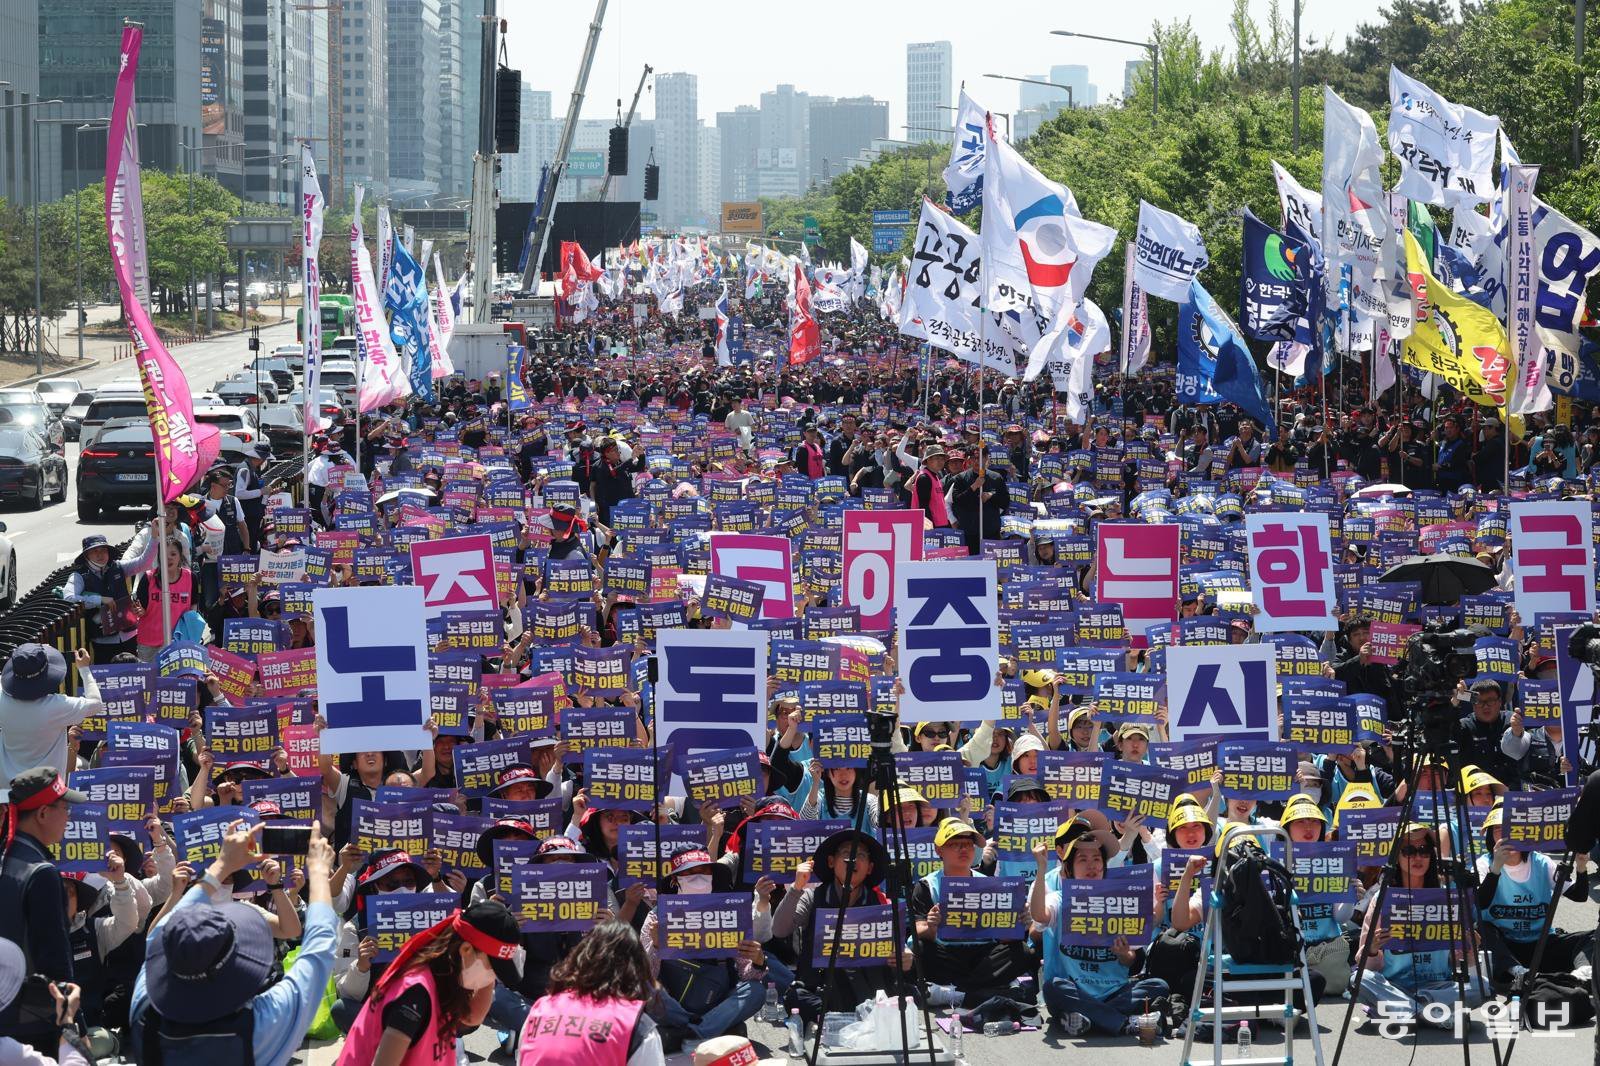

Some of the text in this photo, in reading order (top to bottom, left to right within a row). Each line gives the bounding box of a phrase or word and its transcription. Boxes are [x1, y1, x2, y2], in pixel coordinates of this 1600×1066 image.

[1516, 206, 1530, 237] 노동
[1516, 241, 1531, 303] 사각지대
[1252, 523, 1328, 617] 한
[1517, 515, 1586, 610] 국
[550, 569, 588, 580] 노동입법
[608, 567, 644, 580] 노동입법
[550, 581, 592, 591] 즉각 이행!
[608, 578, 646, 590] 즉각 이행!
[707, 585, 756, 605] 노동입법
[707, 595, 755, 617] 즉각 이행!
[1362, 598, 1402, 614] 노동입법
[1465, 605, 1502, 619] 노동입법
[535, 613, 575, 626] 노동입법
[642, 613, 679, 628] 노동입법
[809, 617, 852, 629] 노동입법
[1079, 615, 1118, 626] 노동입법
[1382, 611, 1403, 624] 이행!
[1482, 618, 1504, 628] 이행!
[229, 629, 272, 641] 노동입법
[447, 622, 493, 633] 노동입법
[534, 622, 579, 638] 즉각 이행!
[1080, 628, 1101, 639] 즉각
[448, 635, 498, 647] 즉각 이행!
[905, 576, 991, 702] 중
[1018, 635, 1064, 648] 노동입법
[1372, 633, 1396, 644] 되찾은
[228, 642, 275, 653] 즉각 이행!
[1372, 646, 1386, 656] 다시
[777, 653, 829, 670] 노동입법
[1019, 650, 1041, 662] 즉각
[263, 663, 290, 676] 되찾은
[321, 606, 423, 734] 노
[575, 658, 622, 673] 노동입법
[1064, 659, 1115, 671] 노동입법
[1296, 662, 1324, 675] 이행!
[599, 675, 627, 688] 이행!
[776, 668, 801, 682] 즉각
[1063, 673, 1088, 686] 즉각
[264, 678, 282, 689] 다시
[805, 694, 858, 707] 노동입법
[1099, 685, 1153, 702] 노동입법
[161, 706, 189, 718] 이행!
[1097, 700, 1159, 714] 즉각 이행!
[1525, 703, 1550, 718] 즉각
[432, 713, 461, 728] 이행!
[518, 716, 547, 731] 이행!
[1291, 711, 1347, 726] 노동입법
[212, 719, 268, 736] 노동입법
[568, 721, 624, 736] 노동입법
[115, 735, 168, 749] 노동입법
[211, 736, 273, 751] 즉각 이행!
[1291, 728, 1352, 744] 즉각 이행!
[289, 738, 321, 752] 되찾은
[820, 744, 846, 758] 즉각
[290, 755, 310, 768] 다시
[461, 752, 520, 774] 노동입법
[1224, 756, 1286, 772] 노동입법
[687, 761, 750, 784] 노동입법
[896, 766, 953, 783] 노동입법
[591, 782, 621, 798] 즉각
[690, 778, 755, 801] 즉각 이행!
[1109, 775, 1172, 800] 노동입법
[1224, 775, 1291, 790] 즉각 이행!
[922, 784, 958, 800] 이행!
[1045, 784, 1072, 799] 즉각
[108, 804, 145, 820] 이행!
[1108, 794, 1173, 819] 즉각 이행!
[1511, 804, 1570, 822] 노동입법
[359, 817, 422, 836] 노동입법
[999, 817, 1057, 833] 노동입법
[1510, 826, 1539, 840] 즉각
[66, 842, 104, 859] 이행!
[998, 836, 1027, 851] 즉각
[521, 881, 591, 899] 노동입법
[1313, 877, 1349, 892] 이행!
[948, 893, 1012, 909] 노동입법
[1071, 897, 1138, 914] 노동입법
[1512, 896, 1533, 904] 교사
[521, 902, 598, 920] 즉각 이행!
[667, 911, 737, 929] 노동입법
[946, 912, 1017, 928] 즉각 이행!
[1071, 917, 1144, 934] 즉각 이행!
[1513, 920, 1530, 931] 회복
[1390, 924, 1422, 939] 즉각
[668, 932, 744, 948] 즉각 이행!
[1079, 962, 1100, 973] 회복
[527, 1015, 614, 1043] 대회진행
